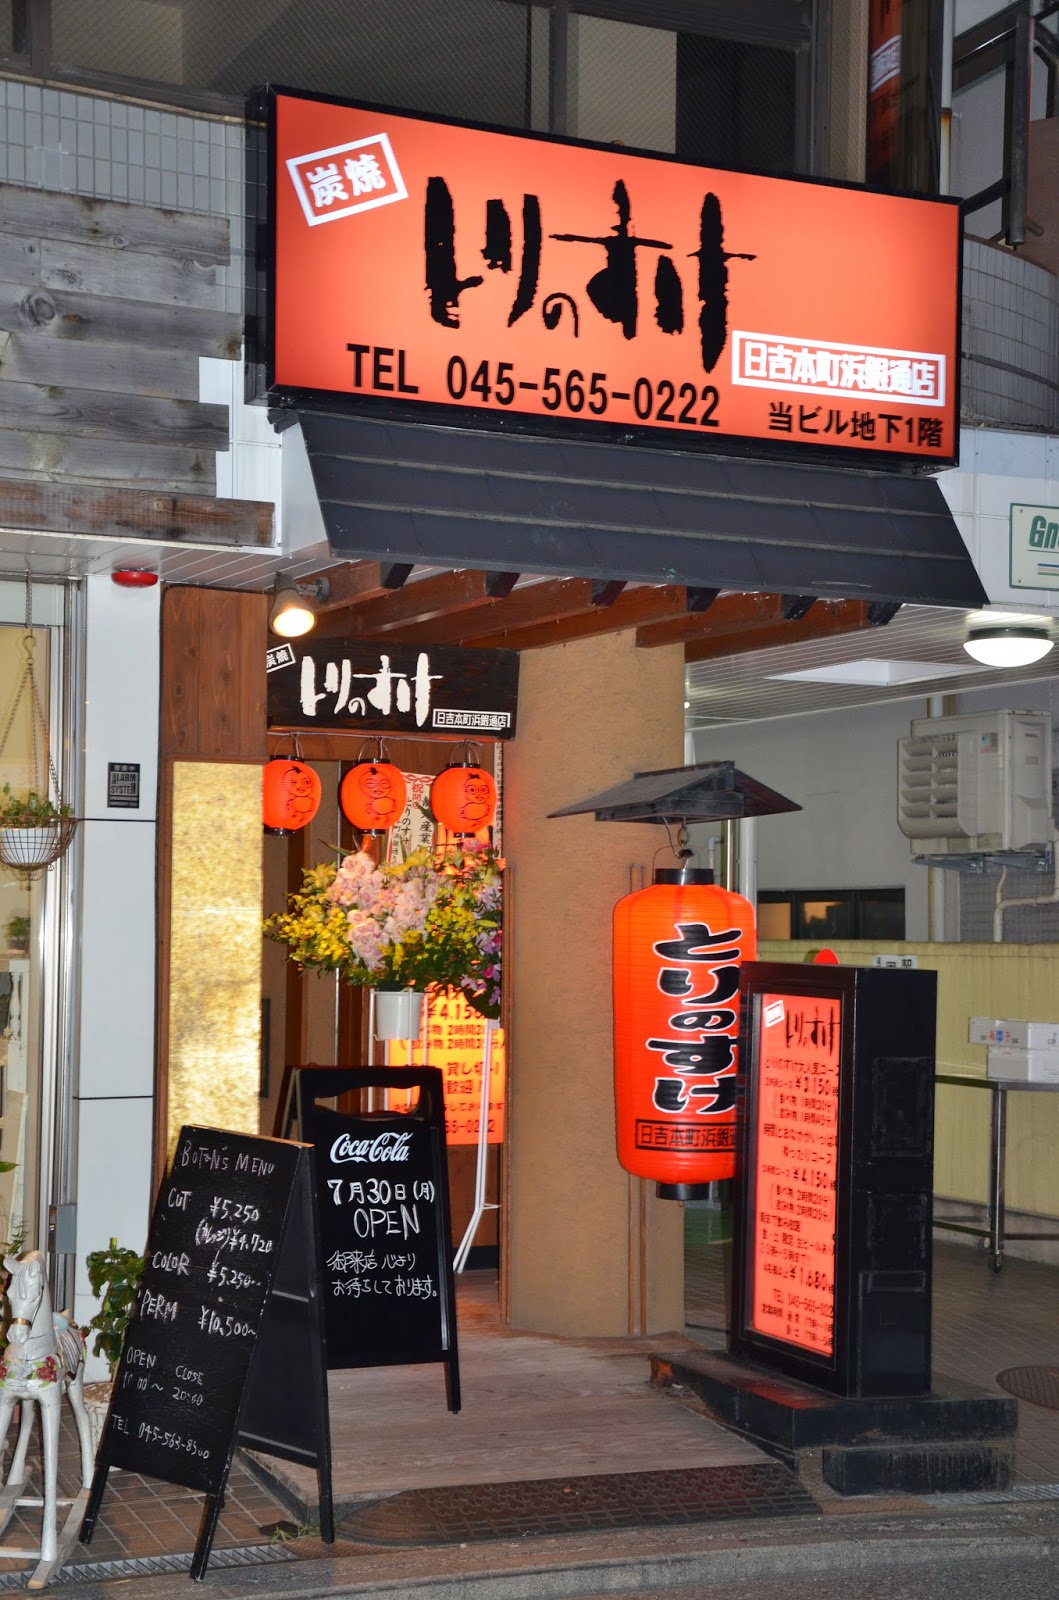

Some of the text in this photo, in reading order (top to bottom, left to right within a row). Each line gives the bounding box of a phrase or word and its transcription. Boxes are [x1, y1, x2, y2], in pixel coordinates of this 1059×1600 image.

[305, 152, 387, 208] 炭焼
[346, 342, 720, 428] TEL 045-565-0222
[744, 340, 936, 398] 日吉本町浜銀通店
[768, 401, 944, 448] 当ビル地下1階
[1029, 515, 1059, 549] Gn
[110, 782, 136, 794] SYSTEM
[112, 773, 136, 784] ALARM
[330, 1132, 414, 1164] Coca-Cola
[235, 1152, 275, 1177] MENU
[353, 1203, 420, 1241] OPEN
[331, 1275, 438, 1300] お待ちしております。
[140, 1288, 178, 1322] PERM
[126, 1346, 156, 1369] OPEN
[175, 1365, 204, 1386] CLOSE
[111, 1413, 129, 1435] TEL
